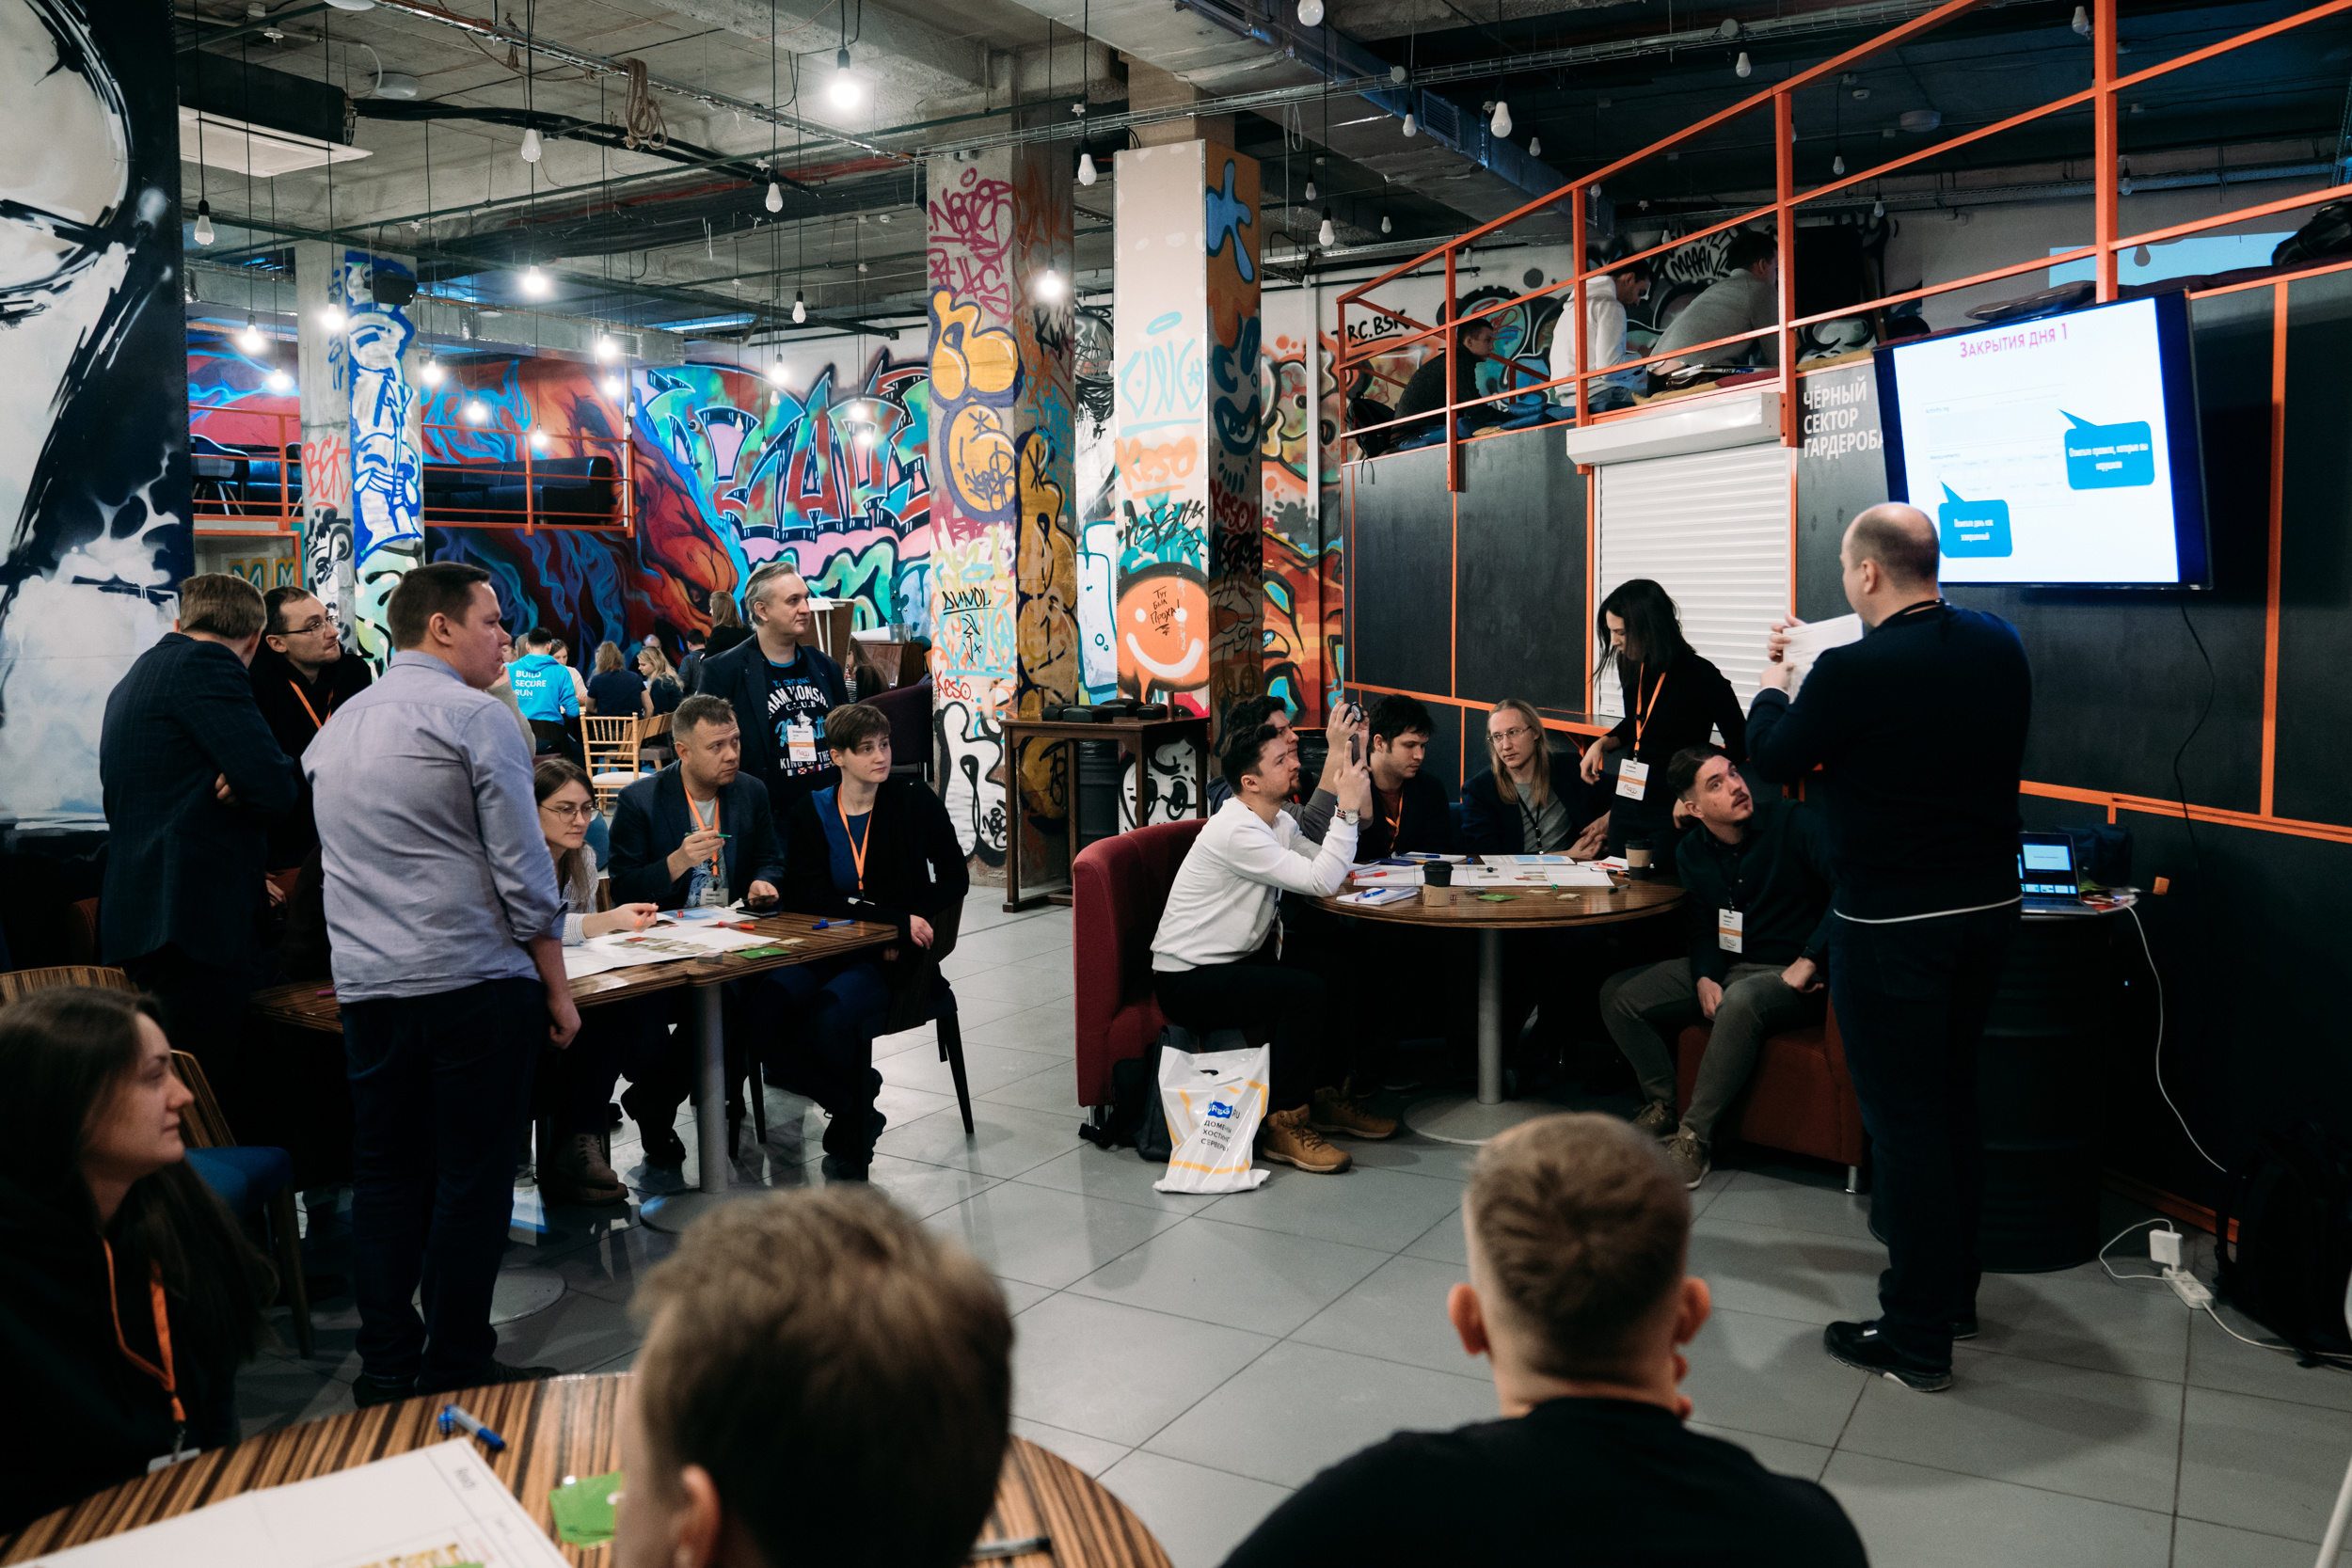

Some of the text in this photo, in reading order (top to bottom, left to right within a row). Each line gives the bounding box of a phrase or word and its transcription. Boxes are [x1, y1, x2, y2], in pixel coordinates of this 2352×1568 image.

[2061, 323, 2068, 340] 1
[1804, 375, 1867, 410] ЧЁРНЫЙ
[1804, 407, 1859, 435] СЕКТОР
[516, 670, 542, 678] BUILD
[515, 679, 548, 688] SECURE
[515, 689, 533, 697] RUN
